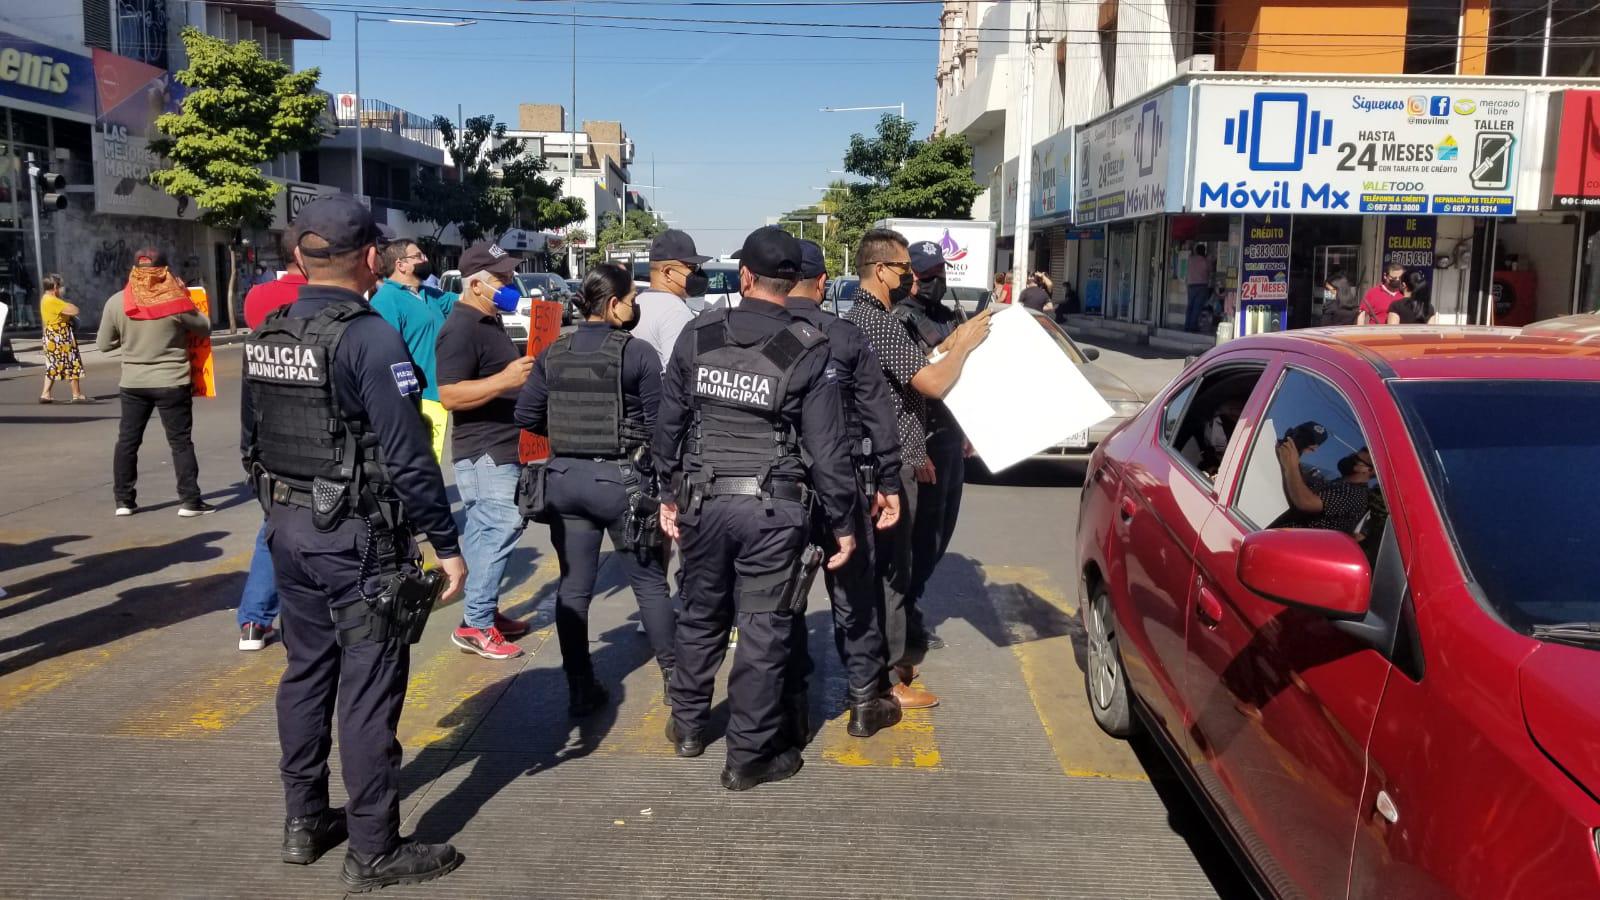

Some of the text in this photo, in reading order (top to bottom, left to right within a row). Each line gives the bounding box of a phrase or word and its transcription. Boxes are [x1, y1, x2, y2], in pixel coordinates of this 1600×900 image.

[1480, 100, 1520, 108] mercado
[1487, 107, 1508, 116] libre
[1408, 117, 1449, 125] @movilmx
[1474, 119, 1514, 131] TALLER
[103, 122, 128, 143] LAS
[1358, 130, 1396, 142] HASTA
[1336, 142, 1434, 172] 24 MESES
[105, 162, 153, 179] MARCA
[1393, 165, 1420, 173] TARJETA
[1125, 184, 1149, 214] Móvil
[1150, 183, 1165, 209] Mx
[1200, 181, 1350, 209] Móvil Mx
[1250, 226, 1284, 239] CRÉDITO
[1406, 218, 1417, 231] DE
[1388, 236, 1432, 249] CELULARES
[1242, 282, 1286, 299] 24 MESES
[245, 344, 318, 368] POLICÍA
[248, 361, 320, 382] MUNICIPAL
[697, 367, 771, 396] POLICÍA
[696, 381, 769, 406] MUNICIPAL
